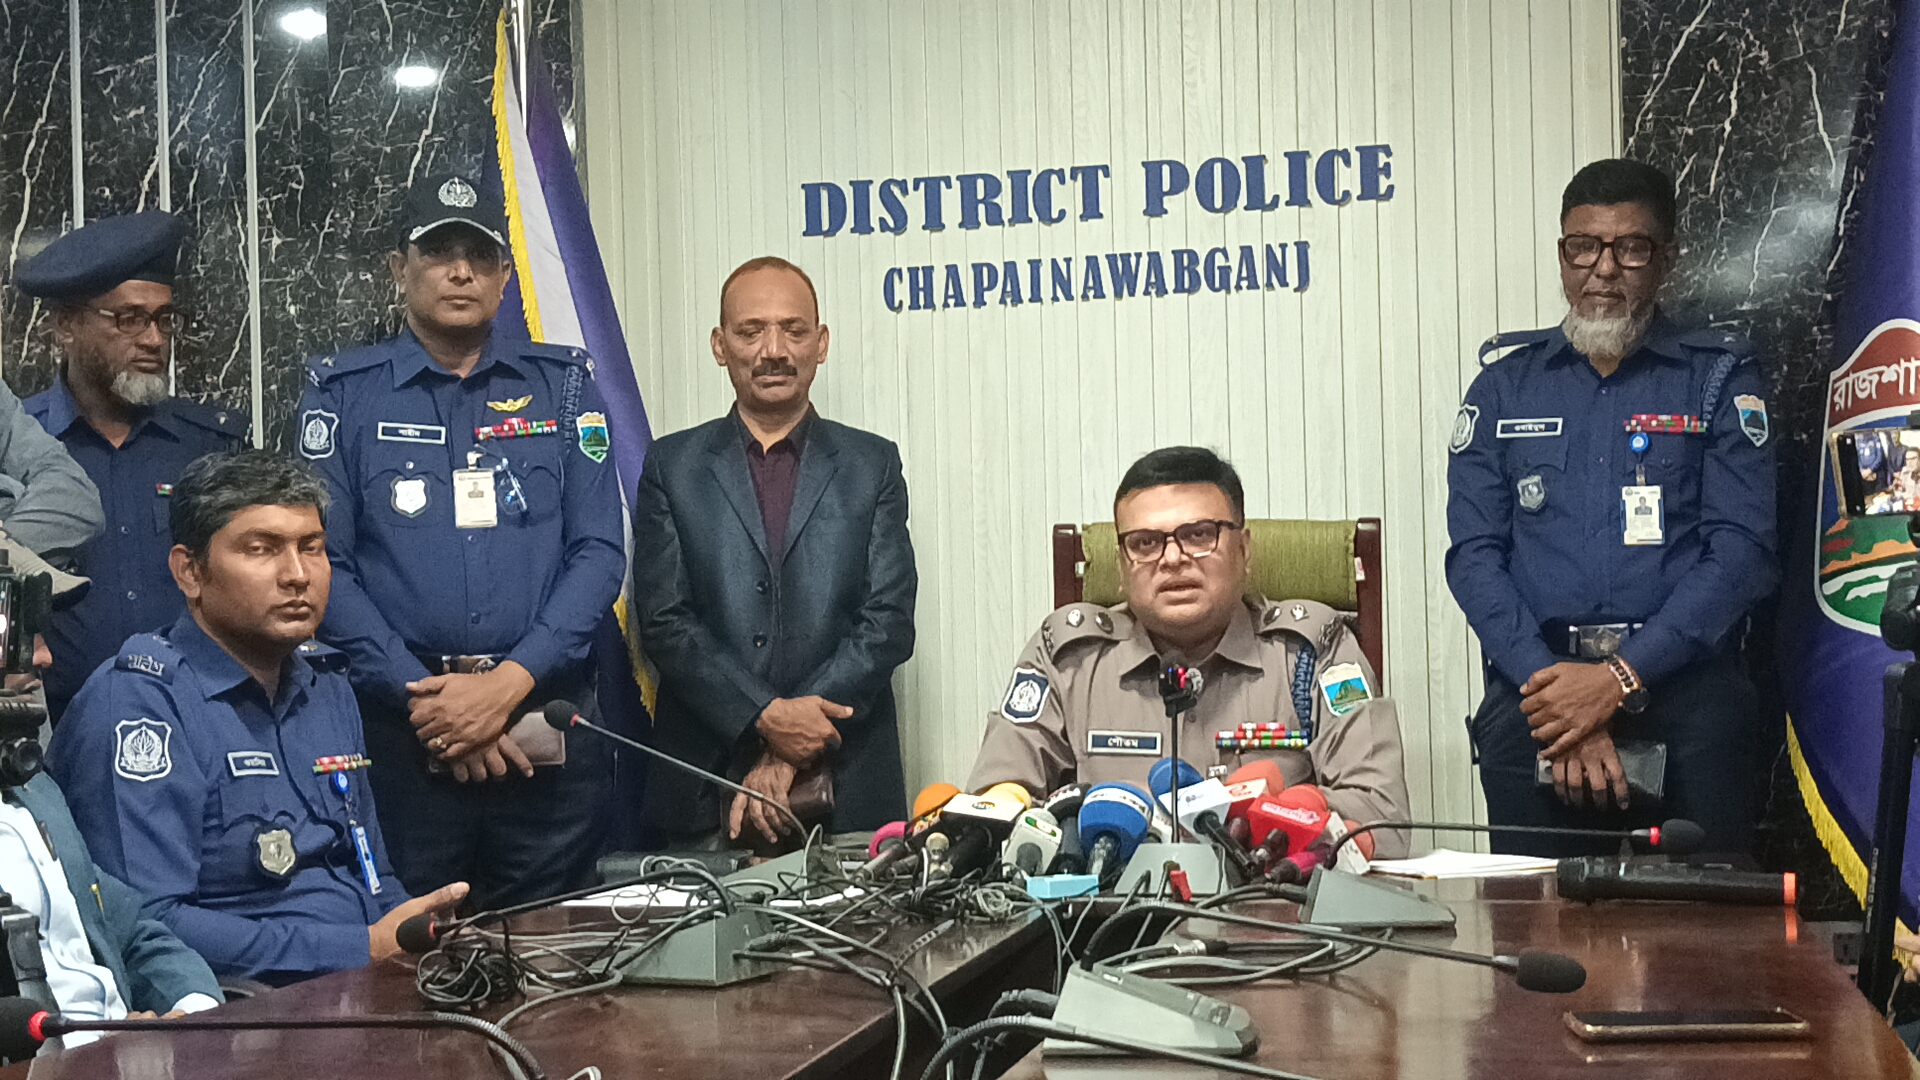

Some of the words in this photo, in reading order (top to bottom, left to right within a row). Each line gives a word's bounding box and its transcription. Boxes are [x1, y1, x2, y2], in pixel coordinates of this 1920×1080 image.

[801, 163, 1111, 238] DISTRICT
[1142, 143, 1396, 218] POLICE
[883, 240, 1311, 313] CHAPAINAWABGANJ
[1833, 355, 1920, 412] রাজশা
[1107, 735, 1139, 748] গৌতম
